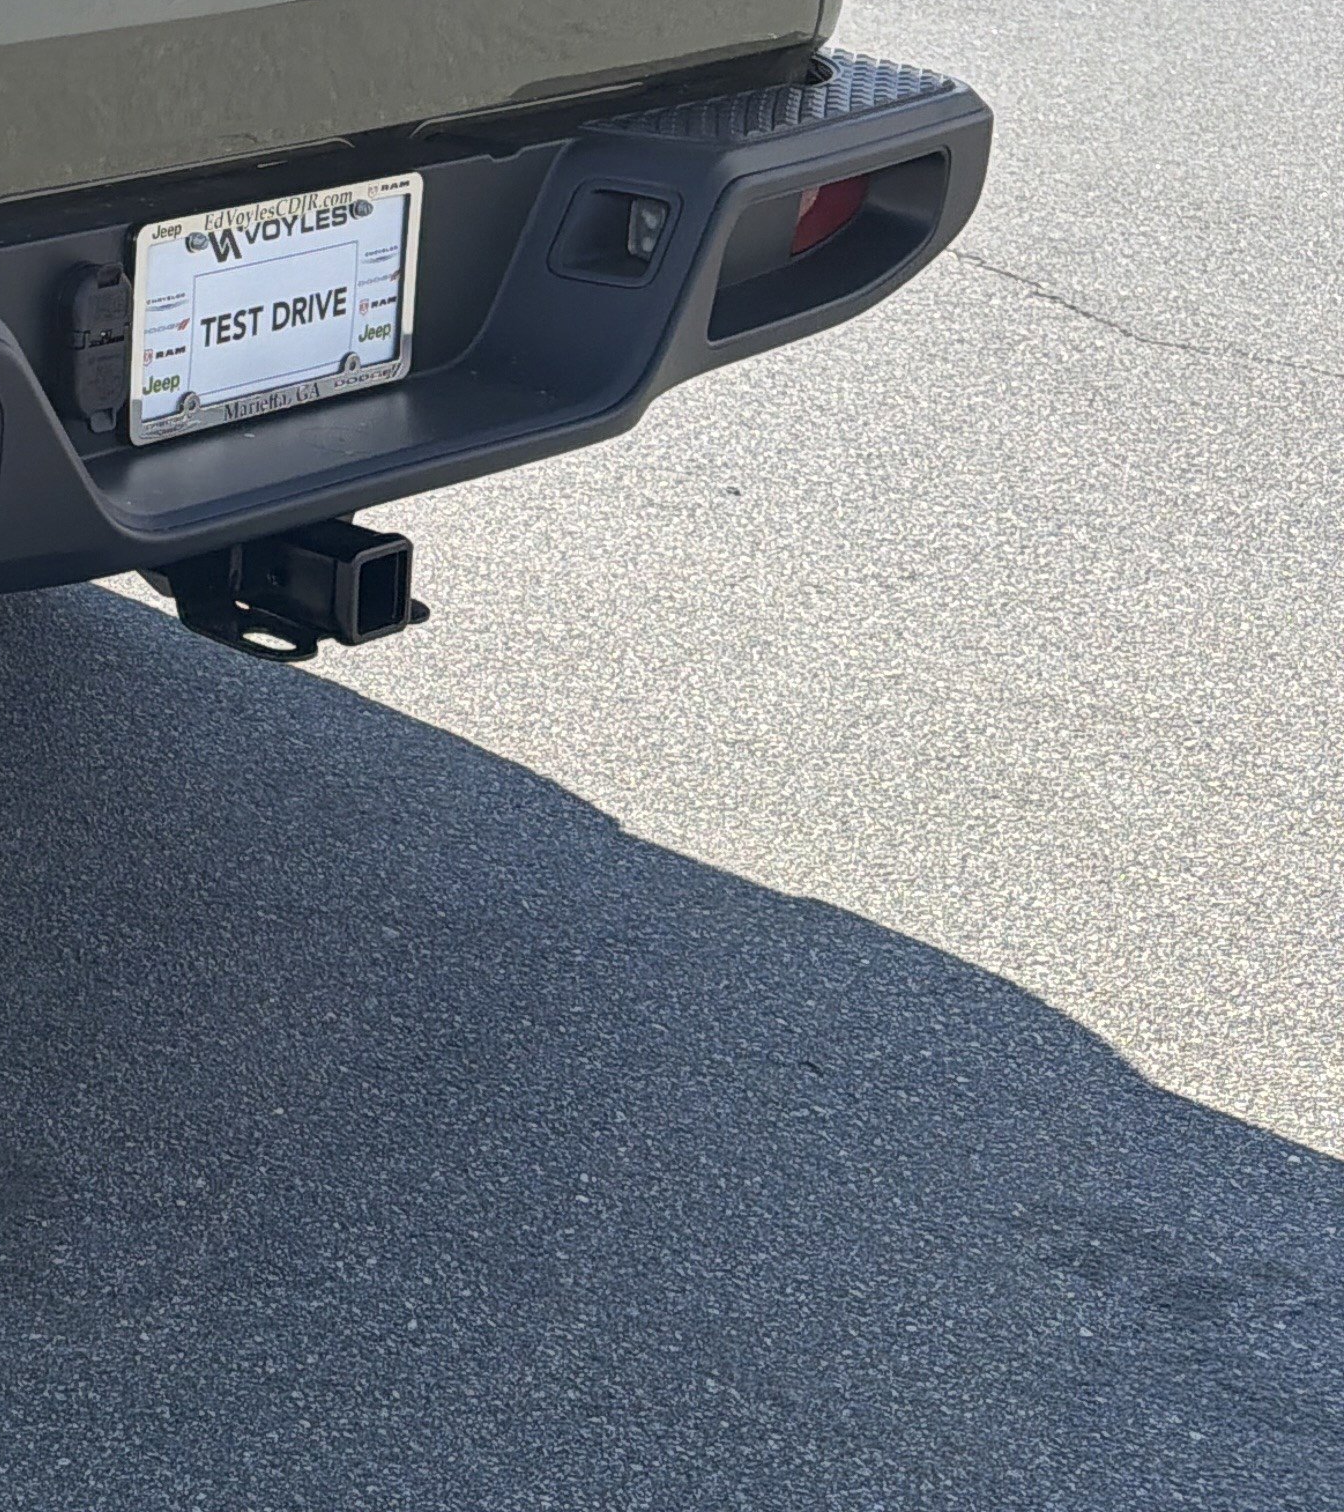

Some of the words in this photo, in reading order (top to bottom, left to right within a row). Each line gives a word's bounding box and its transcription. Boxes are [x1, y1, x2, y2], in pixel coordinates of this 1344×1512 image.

[380, 180, 410, 193] RAM
[151, 221, 182, 239] Jeep
[237, 205, 348, 245] VOYLES
[371, 296, 397, 309] RAM
[200, 305, 264, 347] TEST
[271, 287, 348, 332] DRIVE
[358, 322, 392, 343] Jeep
[155, 346, 186, 359] RAM
[142, 374, 181, 396] Jeep
